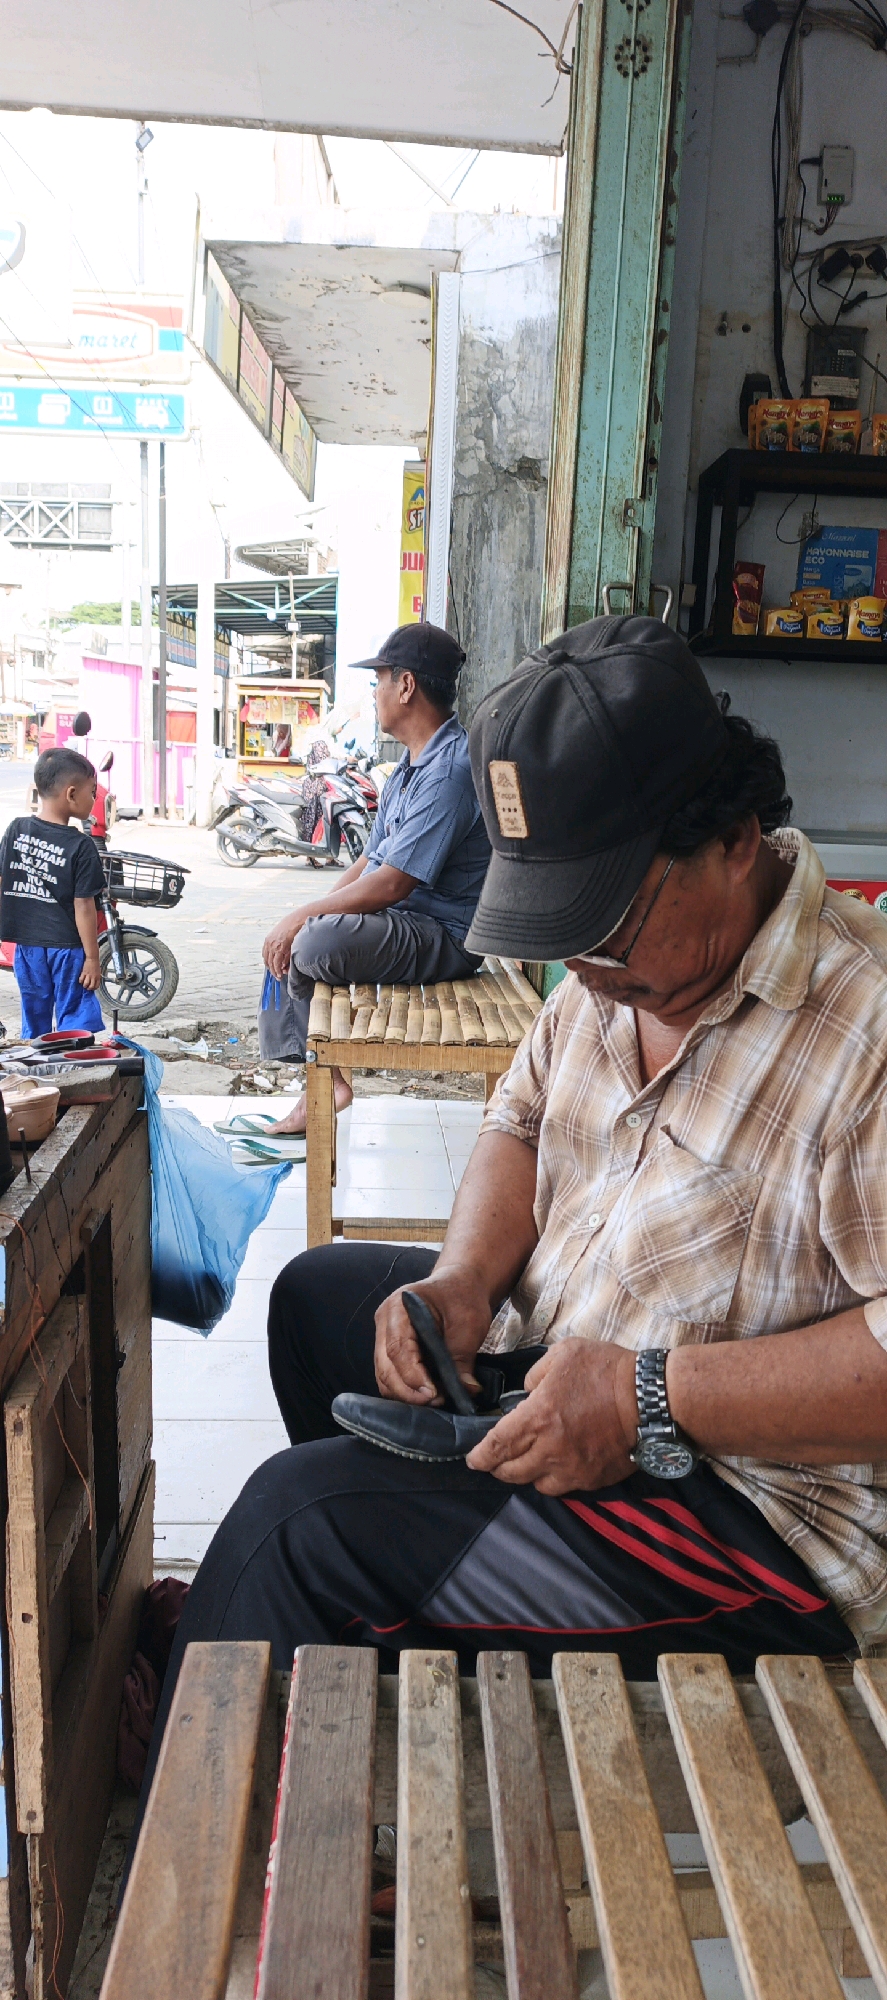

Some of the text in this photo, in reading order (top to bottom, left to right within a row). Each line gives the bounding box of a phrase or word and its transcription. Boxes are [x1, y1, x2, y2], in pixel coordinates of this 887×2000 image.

[805, 556, 825, 564] ECO
[13, 840, 67, 867] DIRUMAH
[17, 833, 65, 856] JANGAN
[9, 861, 58, 885] INDONESIA
[20, 853, 49, 873] SAJA
[26, 873, 44, 887] ITU
